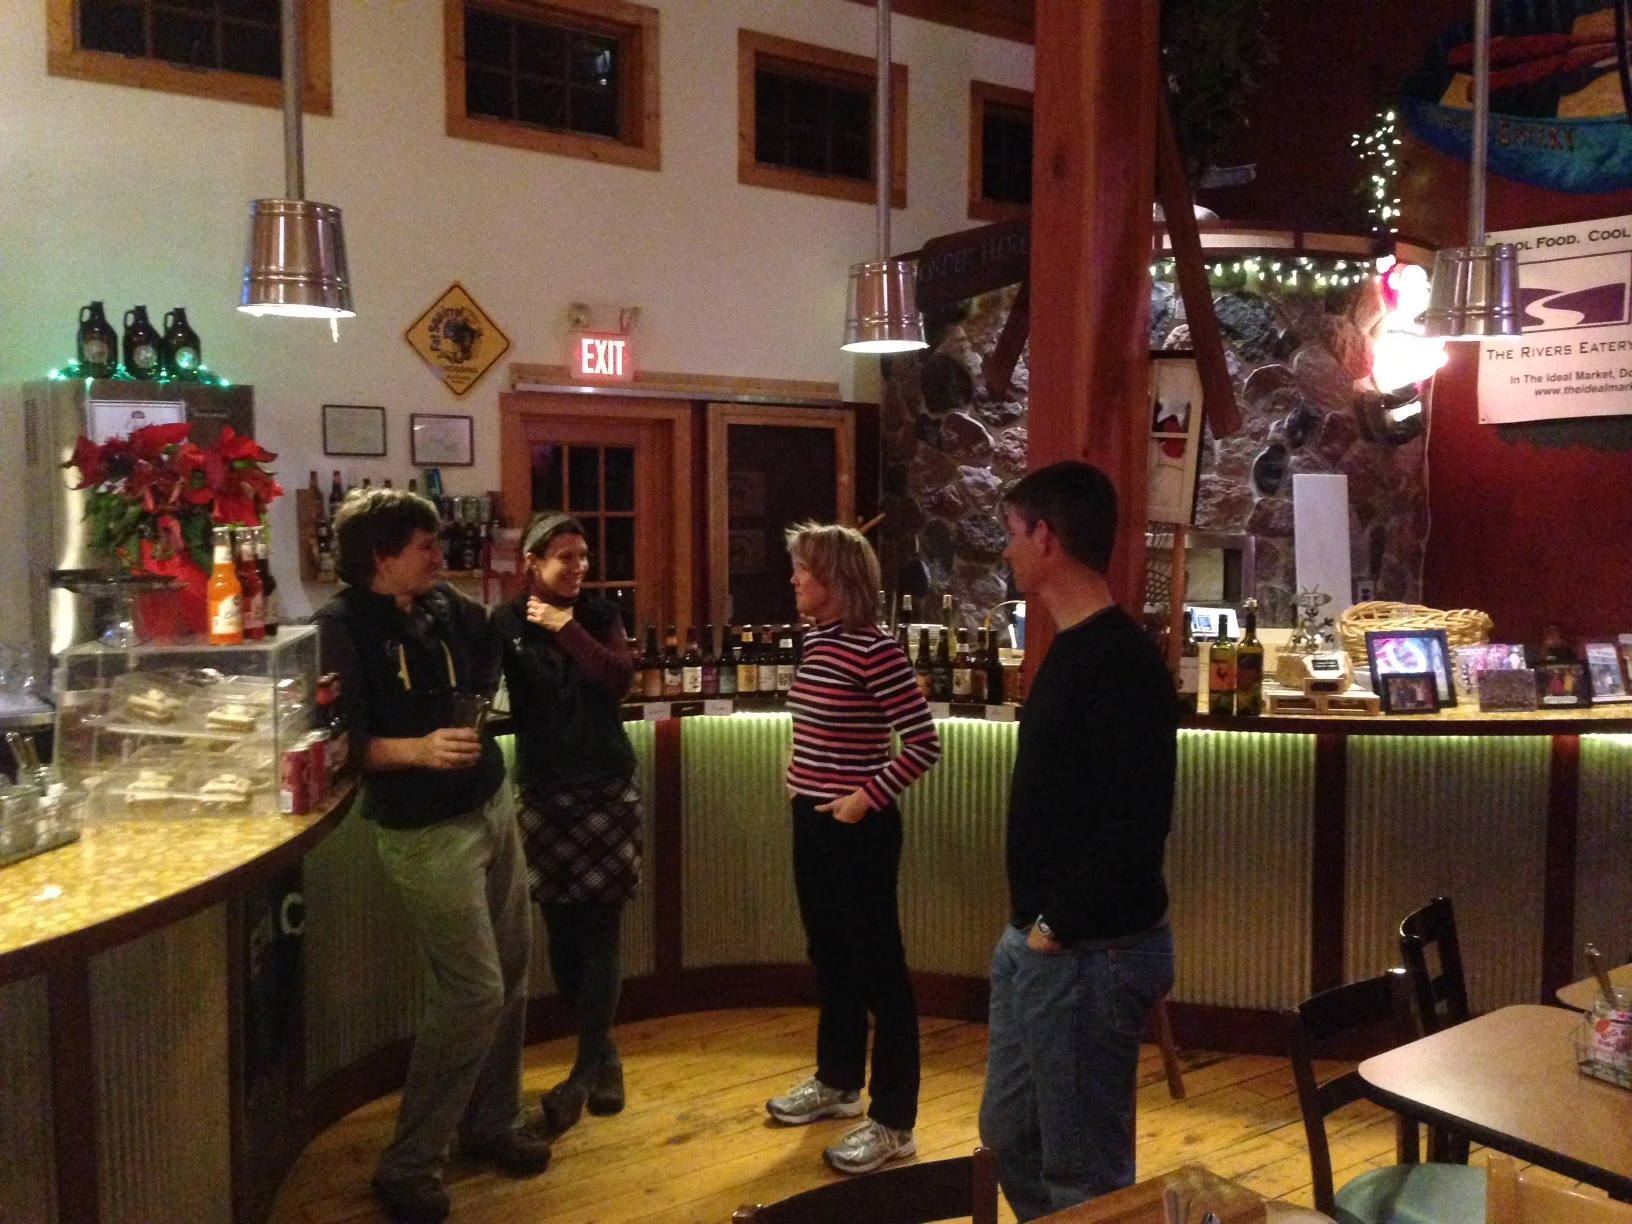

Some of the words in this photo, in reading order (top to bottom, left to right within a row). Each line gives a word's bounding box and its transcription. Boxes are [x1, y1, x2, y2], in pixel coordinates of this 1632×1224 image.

[1536, 235, 1580, 249] FOOD.
[1588, 228, 1631, 243] COOL
[581, 337, 626, 376] EXIT
[1486, 348, 1514, 361] THE
[1521, 343, 1572, 359] RIVERS
[1580, 341, 1632, 353] EATERY
[1510, 375, 1520, 385] In
[1524, 374, 1543, 384] The
[1547, 372, 1572, 382] Ideal
[1575, 370, 1616, 380] Market,
